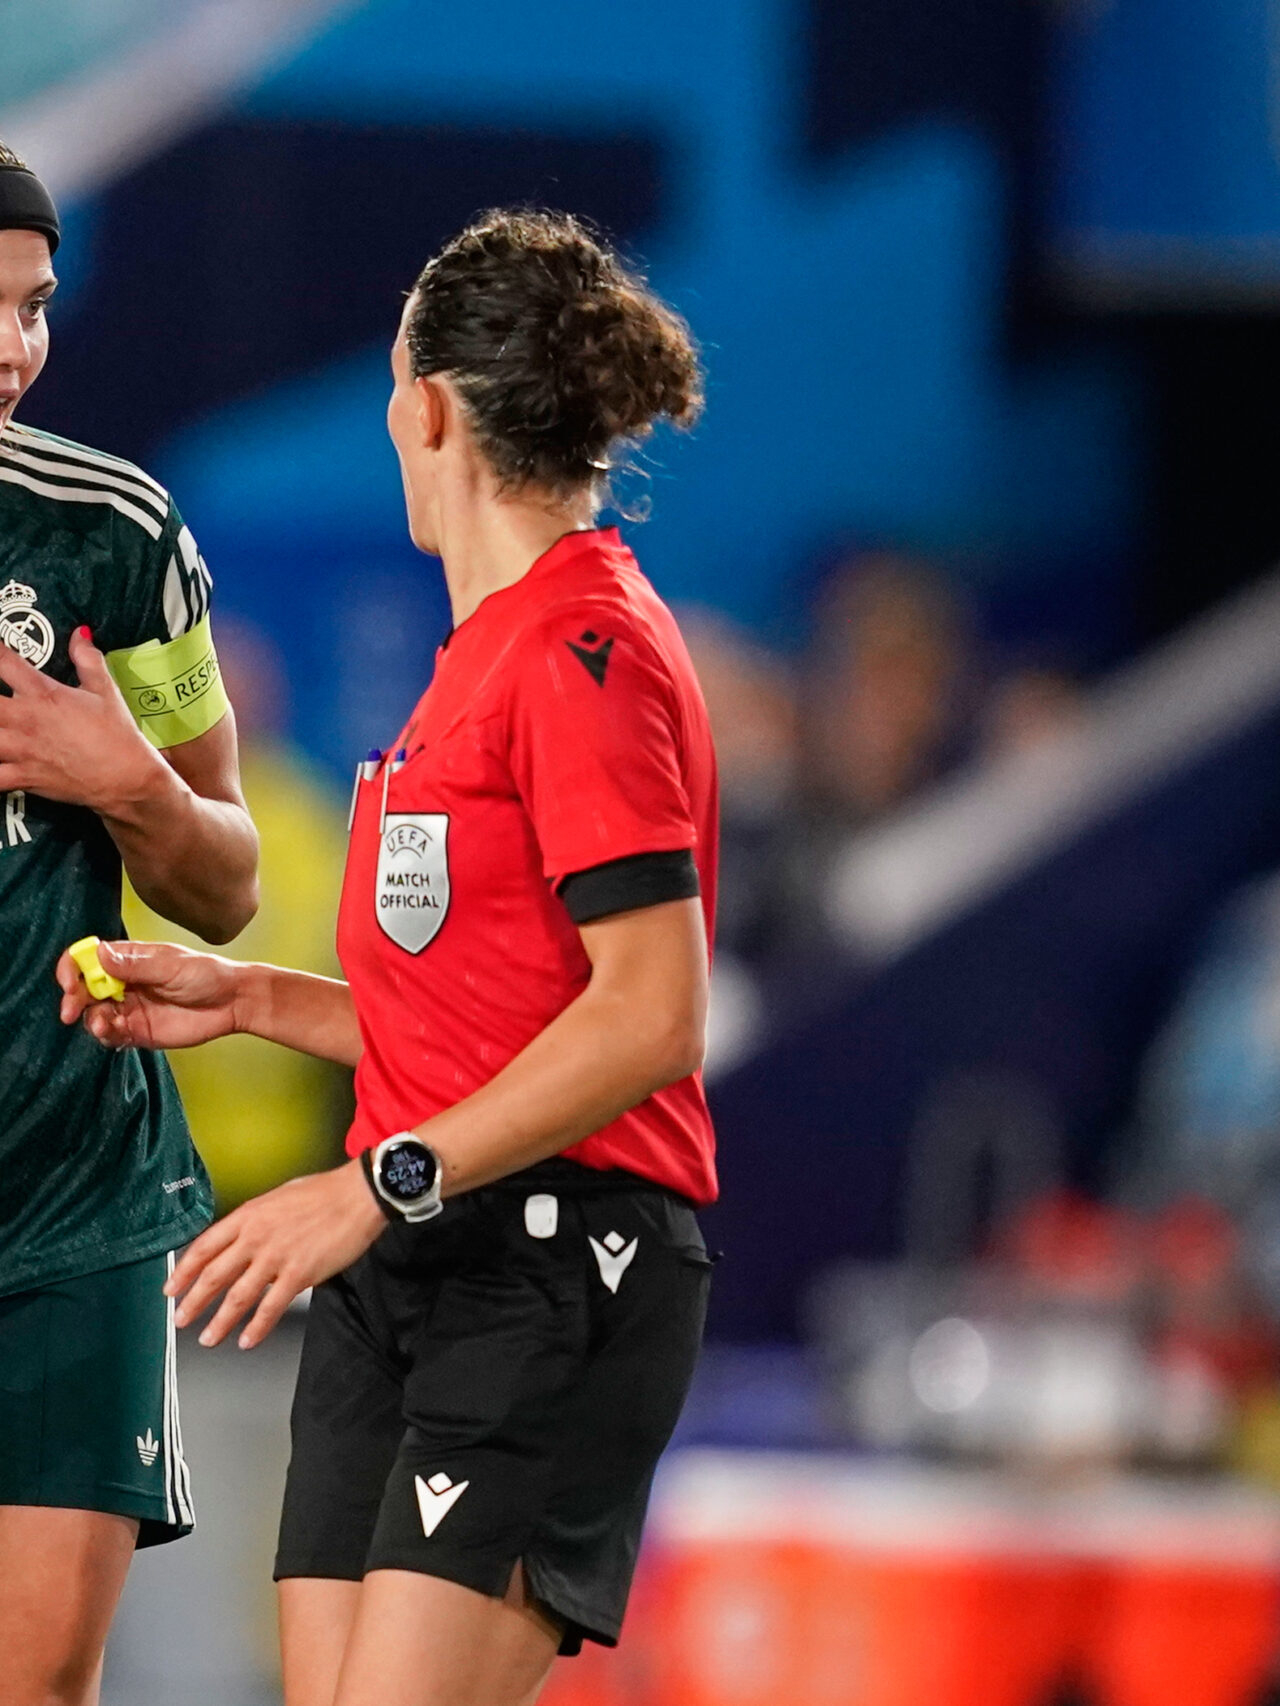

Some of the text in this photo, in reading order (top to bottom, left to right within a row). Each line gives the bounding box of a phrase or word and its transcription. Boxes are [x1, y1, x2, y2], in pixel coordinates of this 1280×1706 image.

[387, 829, 428, 854] UEFA
[386, 873, 430, 887] MATCH
[380, 895, 439, 908] OFFICIAL
